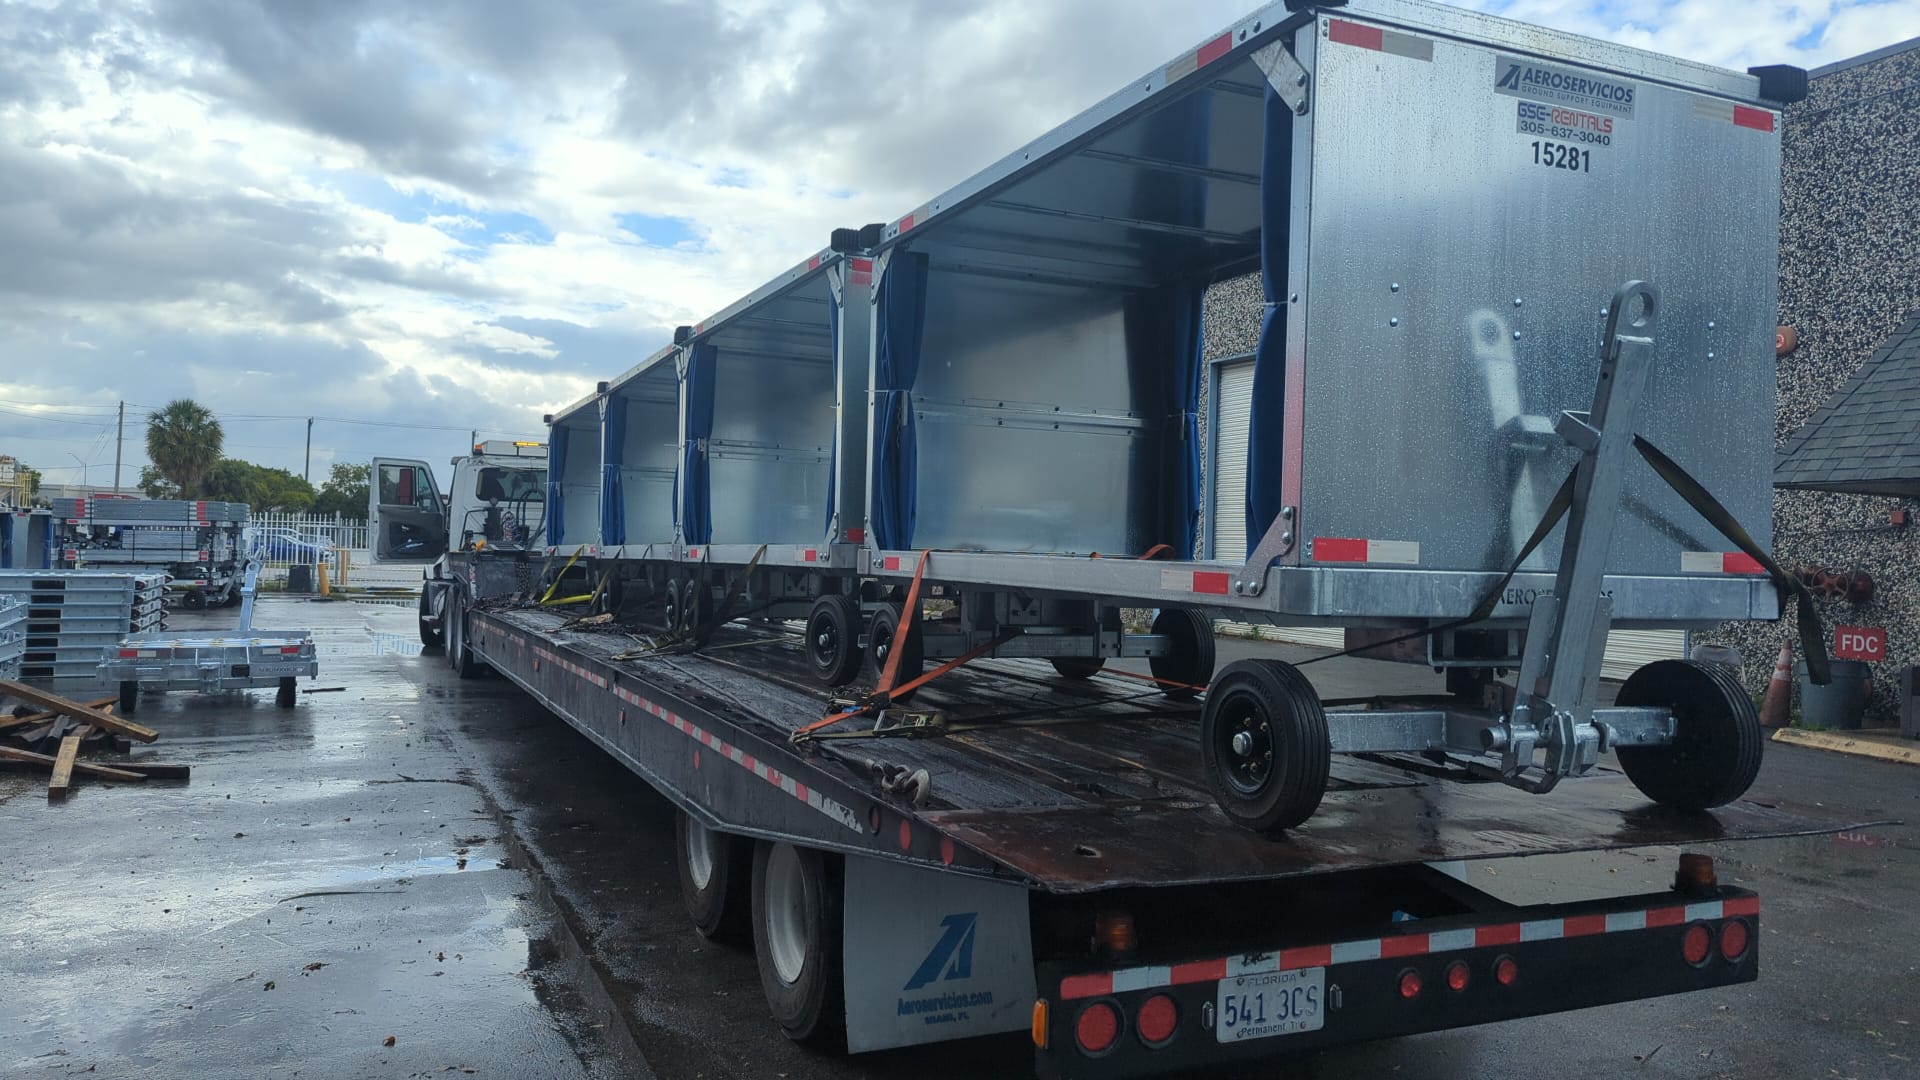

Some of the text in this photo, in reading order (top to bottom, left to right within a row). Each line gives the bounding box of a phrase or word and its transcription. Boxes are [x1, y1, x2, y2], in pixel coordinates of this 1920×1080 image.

[1522, 67, 1633, 103] AEROSERVICIOS
[1521, 86, 1632, 114] GROUND SUPPORT EQUIPMENT
[1517, 102, 1613, 134] GSE-RENTALS
[1520, 120, 1611, 146] 305-637-3040
[1531, 140, 1590, 173] 15281
[1842, 634, 1878, 653] FDC
[1247, 974, 1297, 986] FLORIDA
[1225, 985, 1318, 1028] 541 3CS
[1241, 1022, 1287, 1036] Permanent
